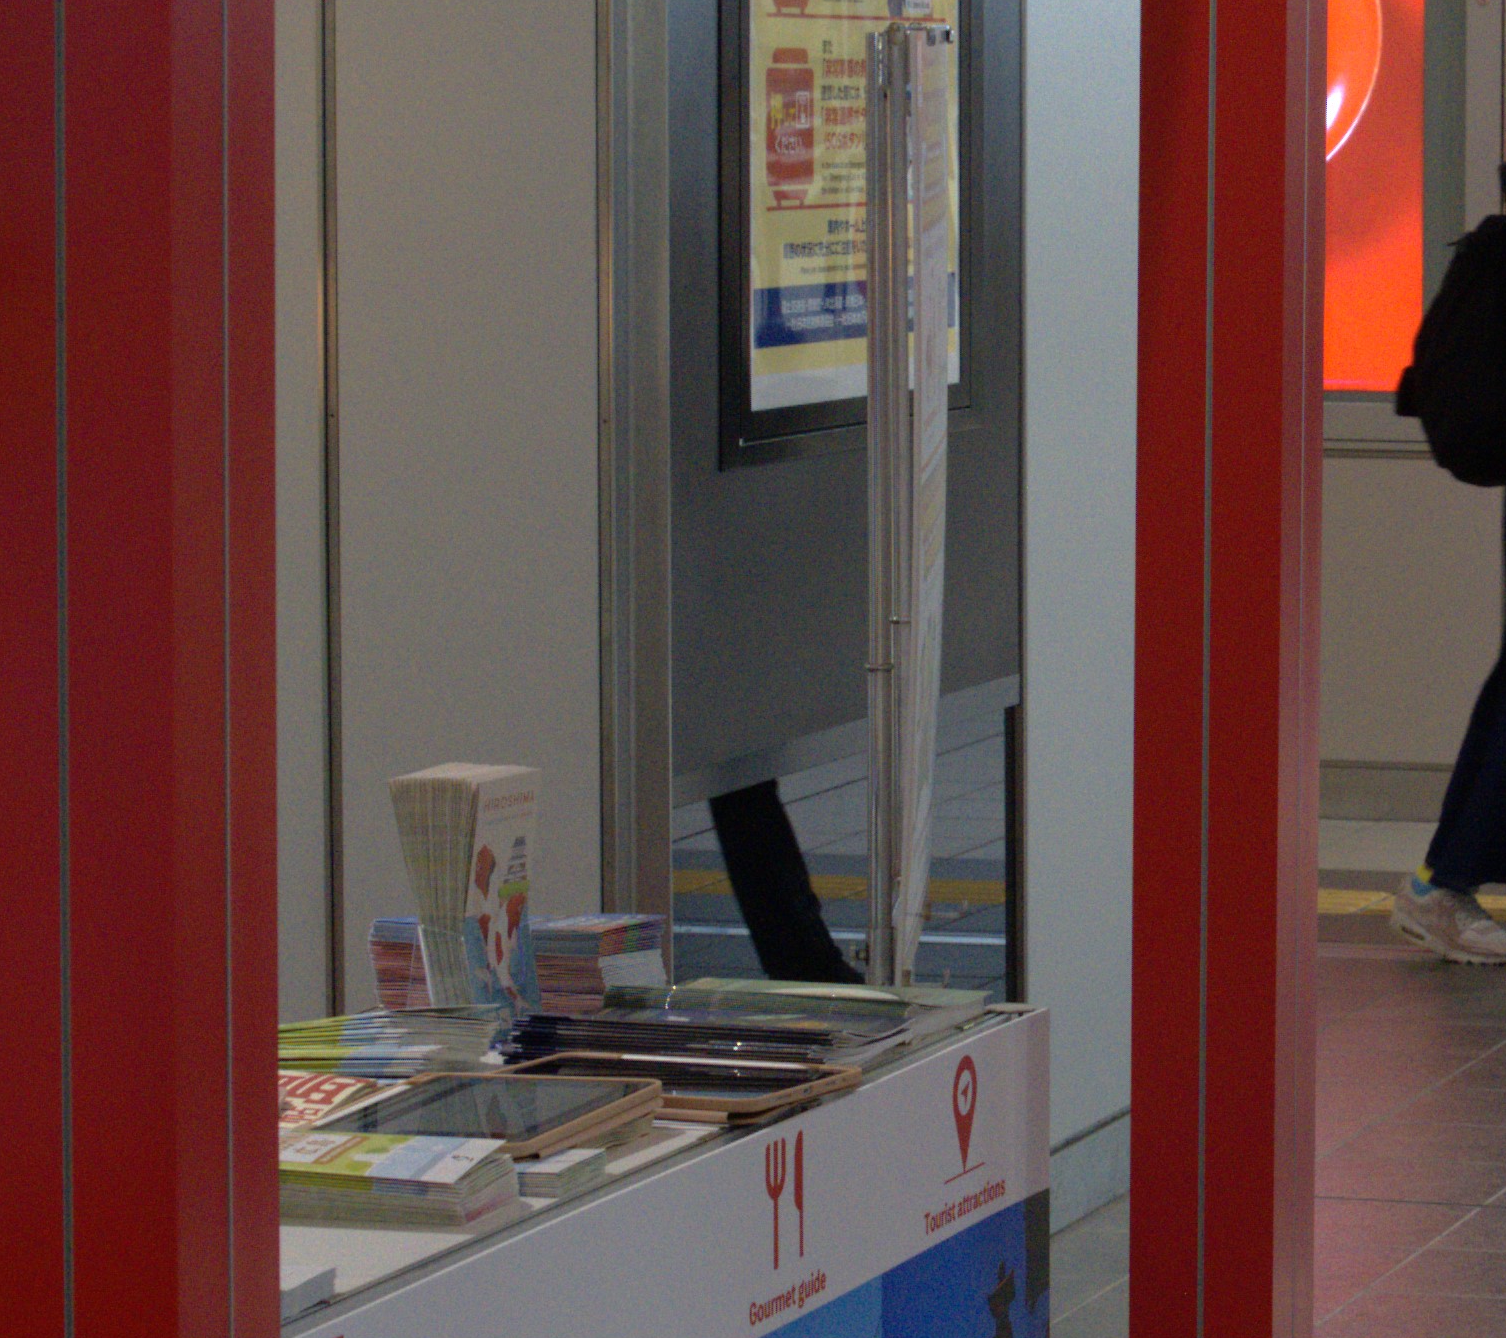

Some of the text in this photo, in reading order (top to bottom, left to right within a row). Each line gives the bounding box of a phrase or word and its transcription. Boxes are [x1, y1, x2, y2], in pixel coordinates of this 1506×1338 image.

[483, 789, 535, 811] HIROSHIMA
[924, 1178, 1006, 1235] Tourist attractions
[749, 1268, 827, 1327] Gourmet guide
